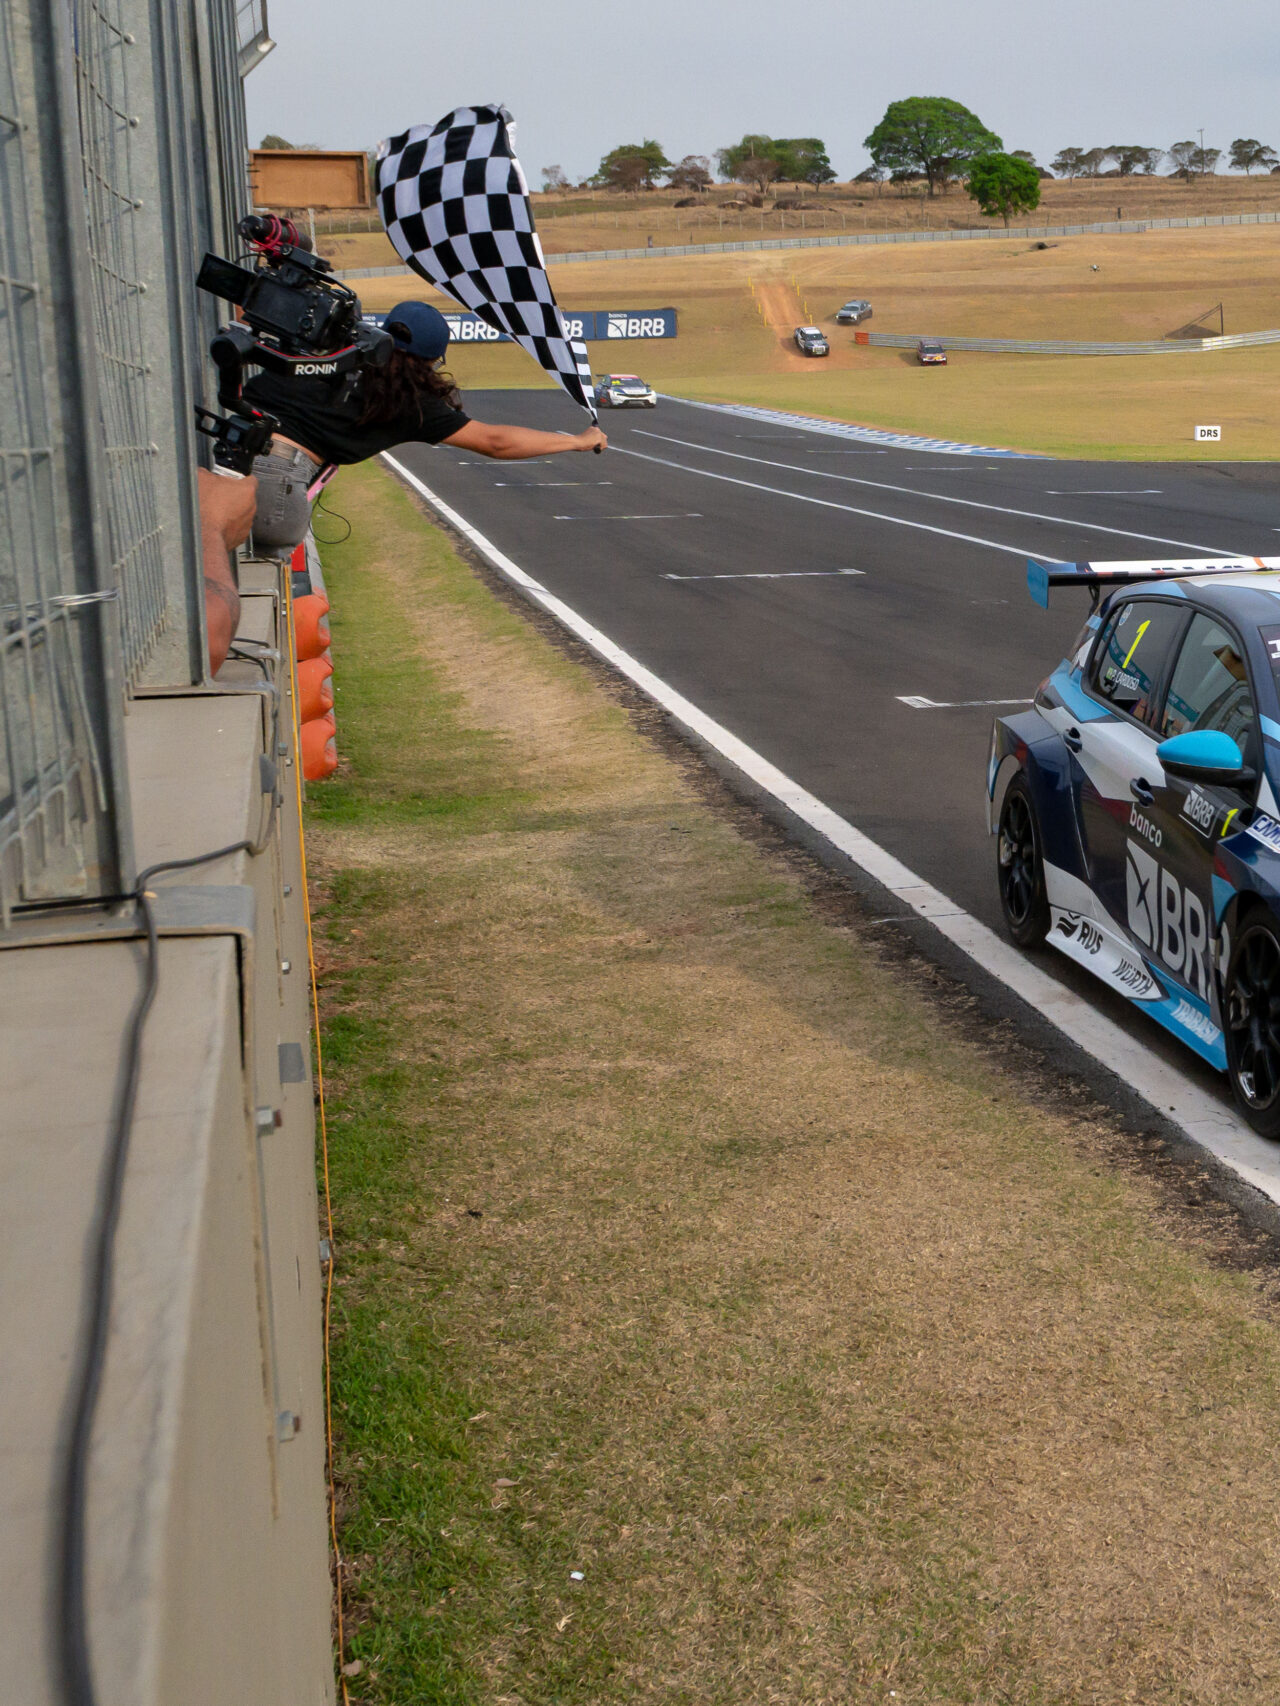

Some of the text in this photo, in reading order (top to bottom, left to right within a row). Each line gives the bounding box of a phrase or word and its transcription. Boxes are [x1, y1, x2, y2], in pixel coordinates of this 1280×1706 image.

[627, 318, 665, 337] BRB
[295, 362, 337, 375] RONIN
[1200, 429, 1218, 437] DRS
[1121, 620, 1151, 669] 1
[1129, 803, 1162, 848] banco
[1193, 797, 1216, 829] BRB
[1220, 809, 1239, 837] 1
[1077, 921, 1104, 955] RUS
[1112, 958, 1153, 996] WÜRTH
